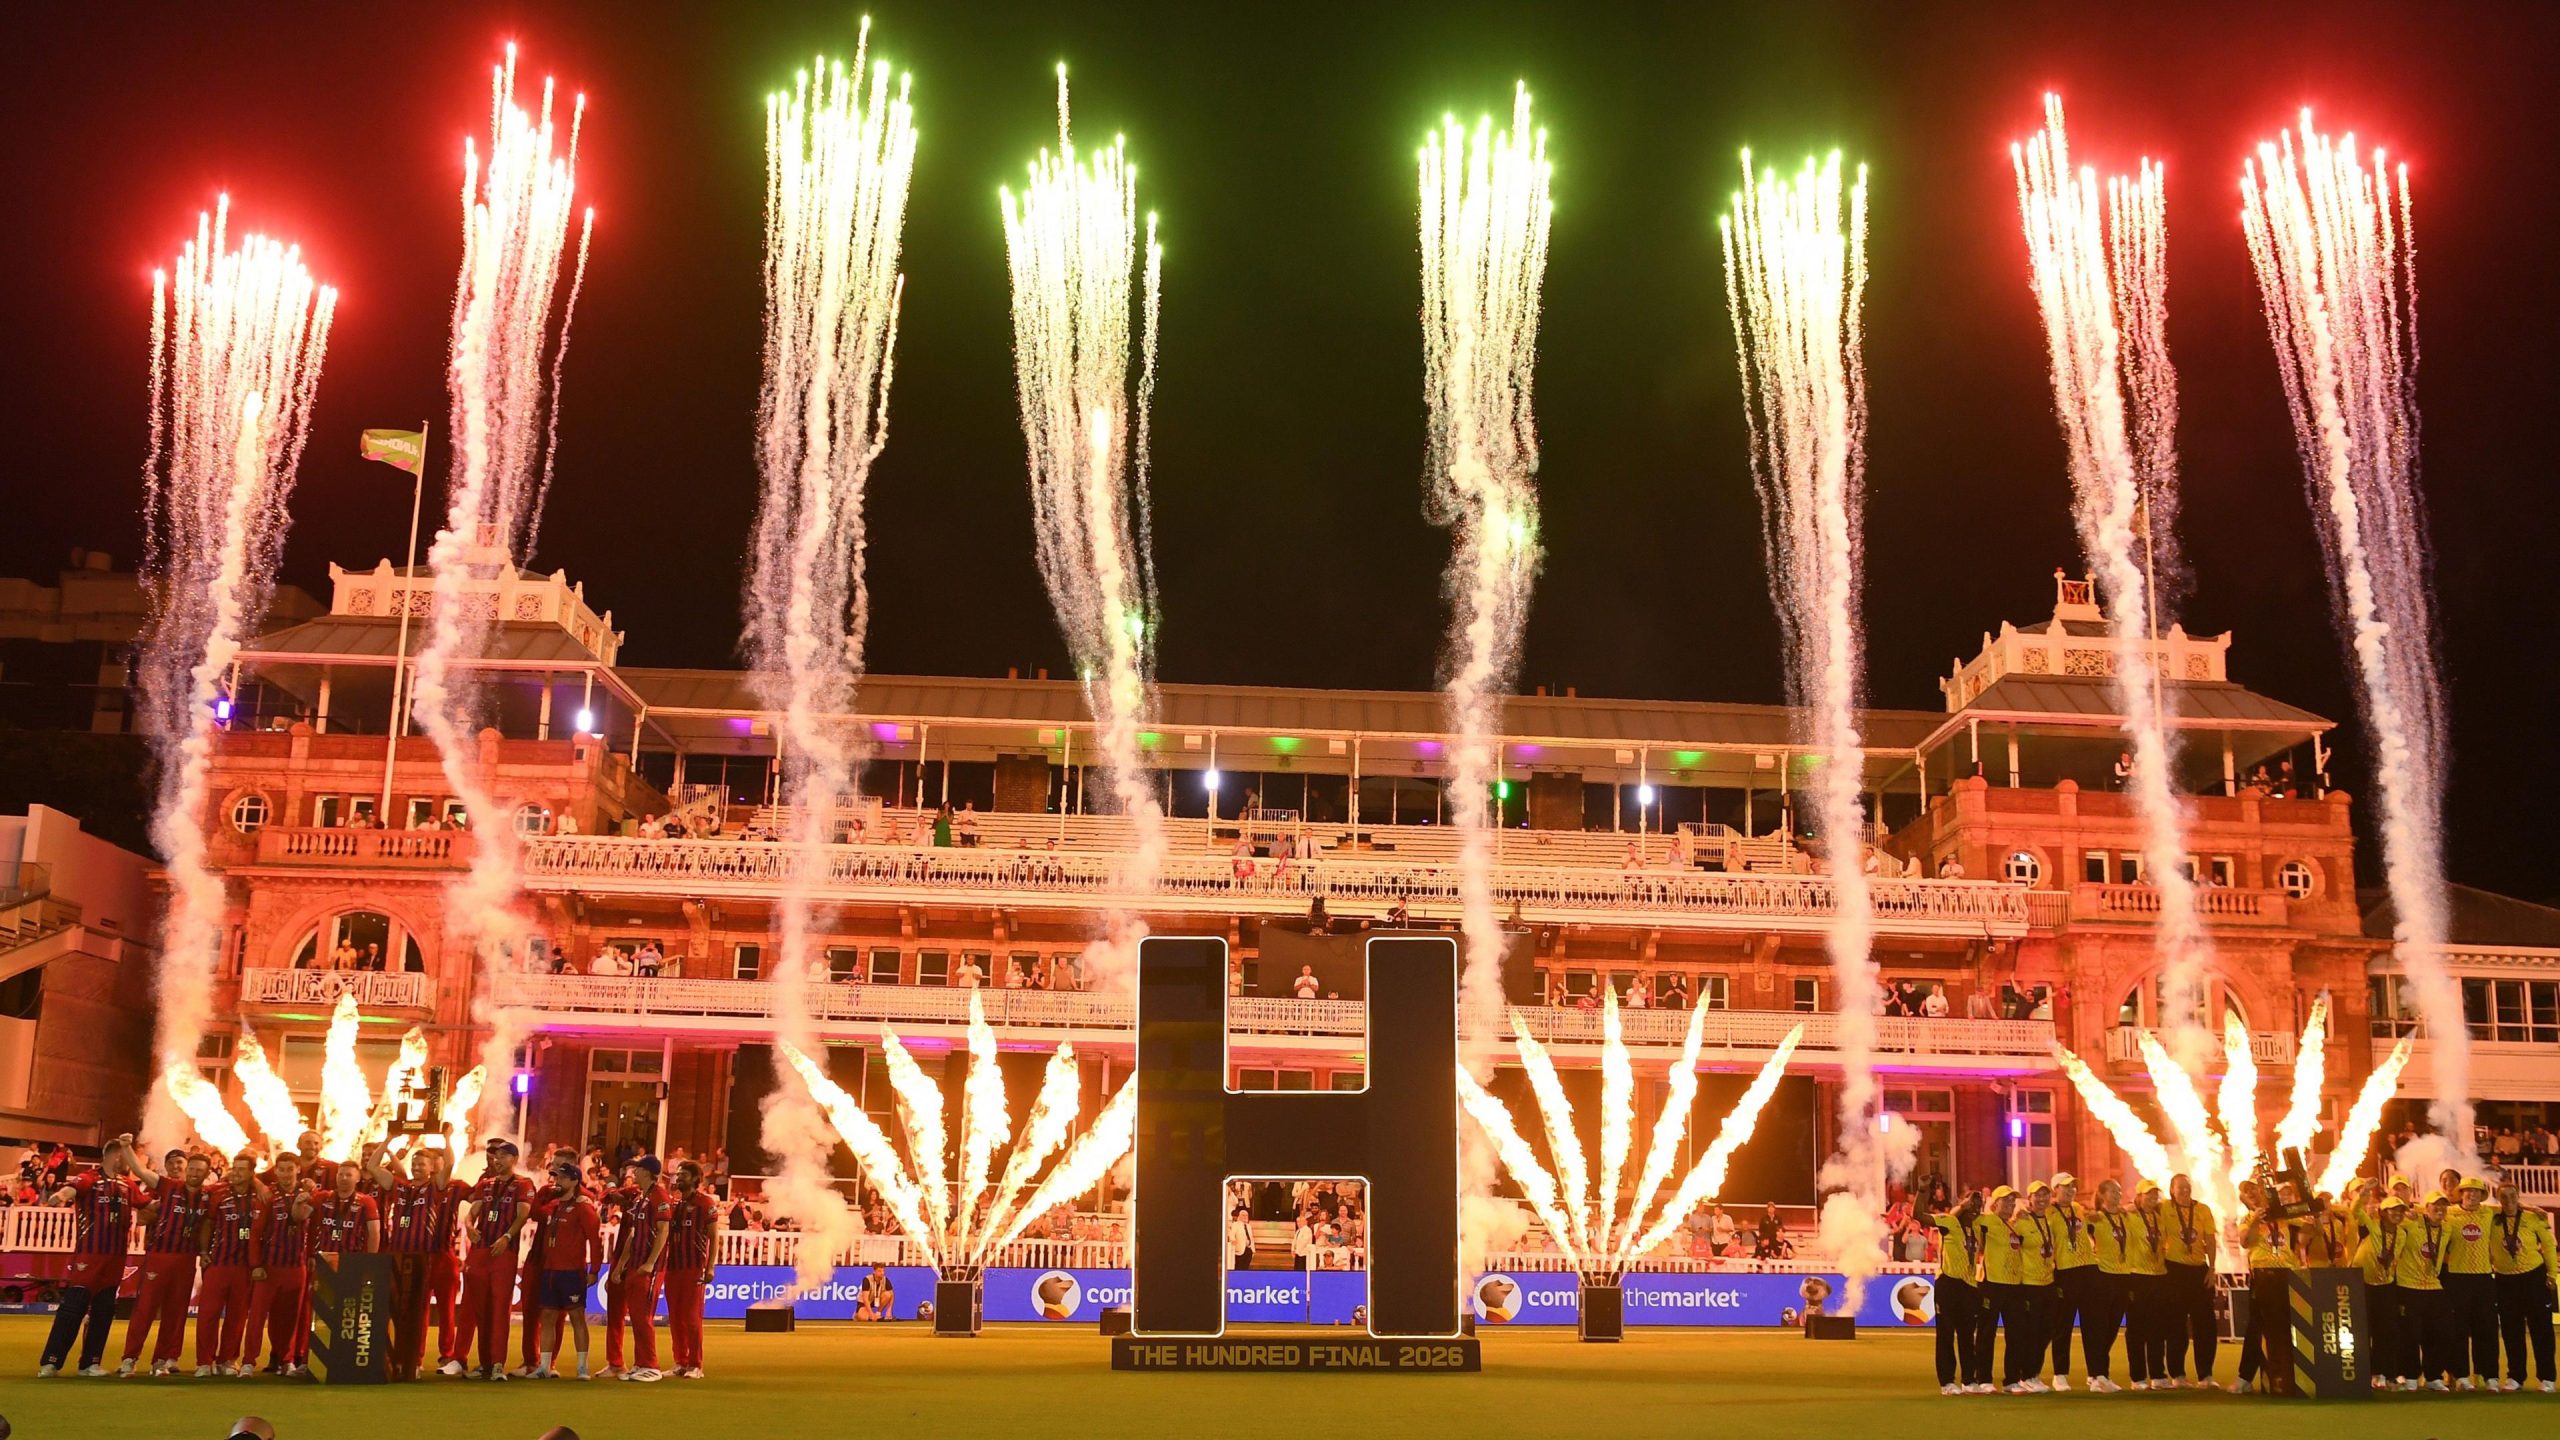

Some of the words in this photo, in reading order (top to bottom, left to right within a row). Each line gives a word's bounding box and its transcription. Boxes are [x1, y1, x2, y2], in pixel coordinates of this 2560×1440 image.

[340, 1297, 357, 1340] 2026
[2322, 1311, 2338, 1355] 2026
[2337, 1285, 2355, 1381] CHAMPIONS
[1129, 1345, 1178, 1366] THE
[1186, 1345, 1300, 1366] HUNDRED
[1309, 1345, 1391, 1367] FINAL
[1399, 1346, 1464, 1367] 2026
